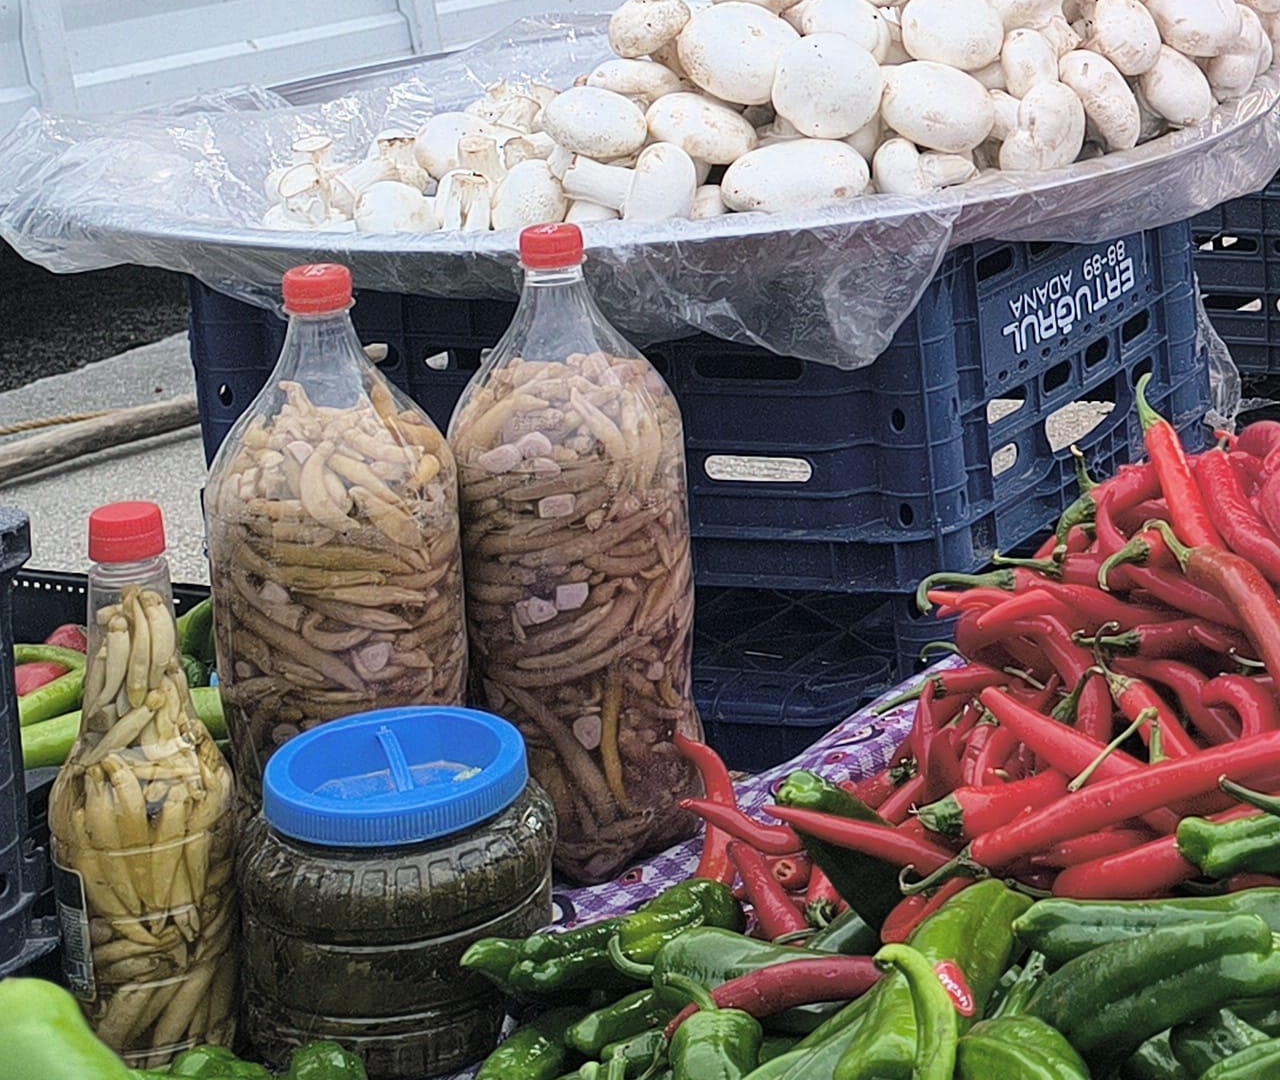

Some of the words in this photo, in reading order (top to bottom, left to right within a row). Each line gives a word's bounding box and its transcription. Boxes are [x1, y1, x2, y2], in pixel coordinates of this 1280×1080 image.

[1083, 239, 1126, 281] 88-89
[1003, 257, 1135, 354] ERTUĞRUL
[1009, 269, 1072, 319] ADANA
